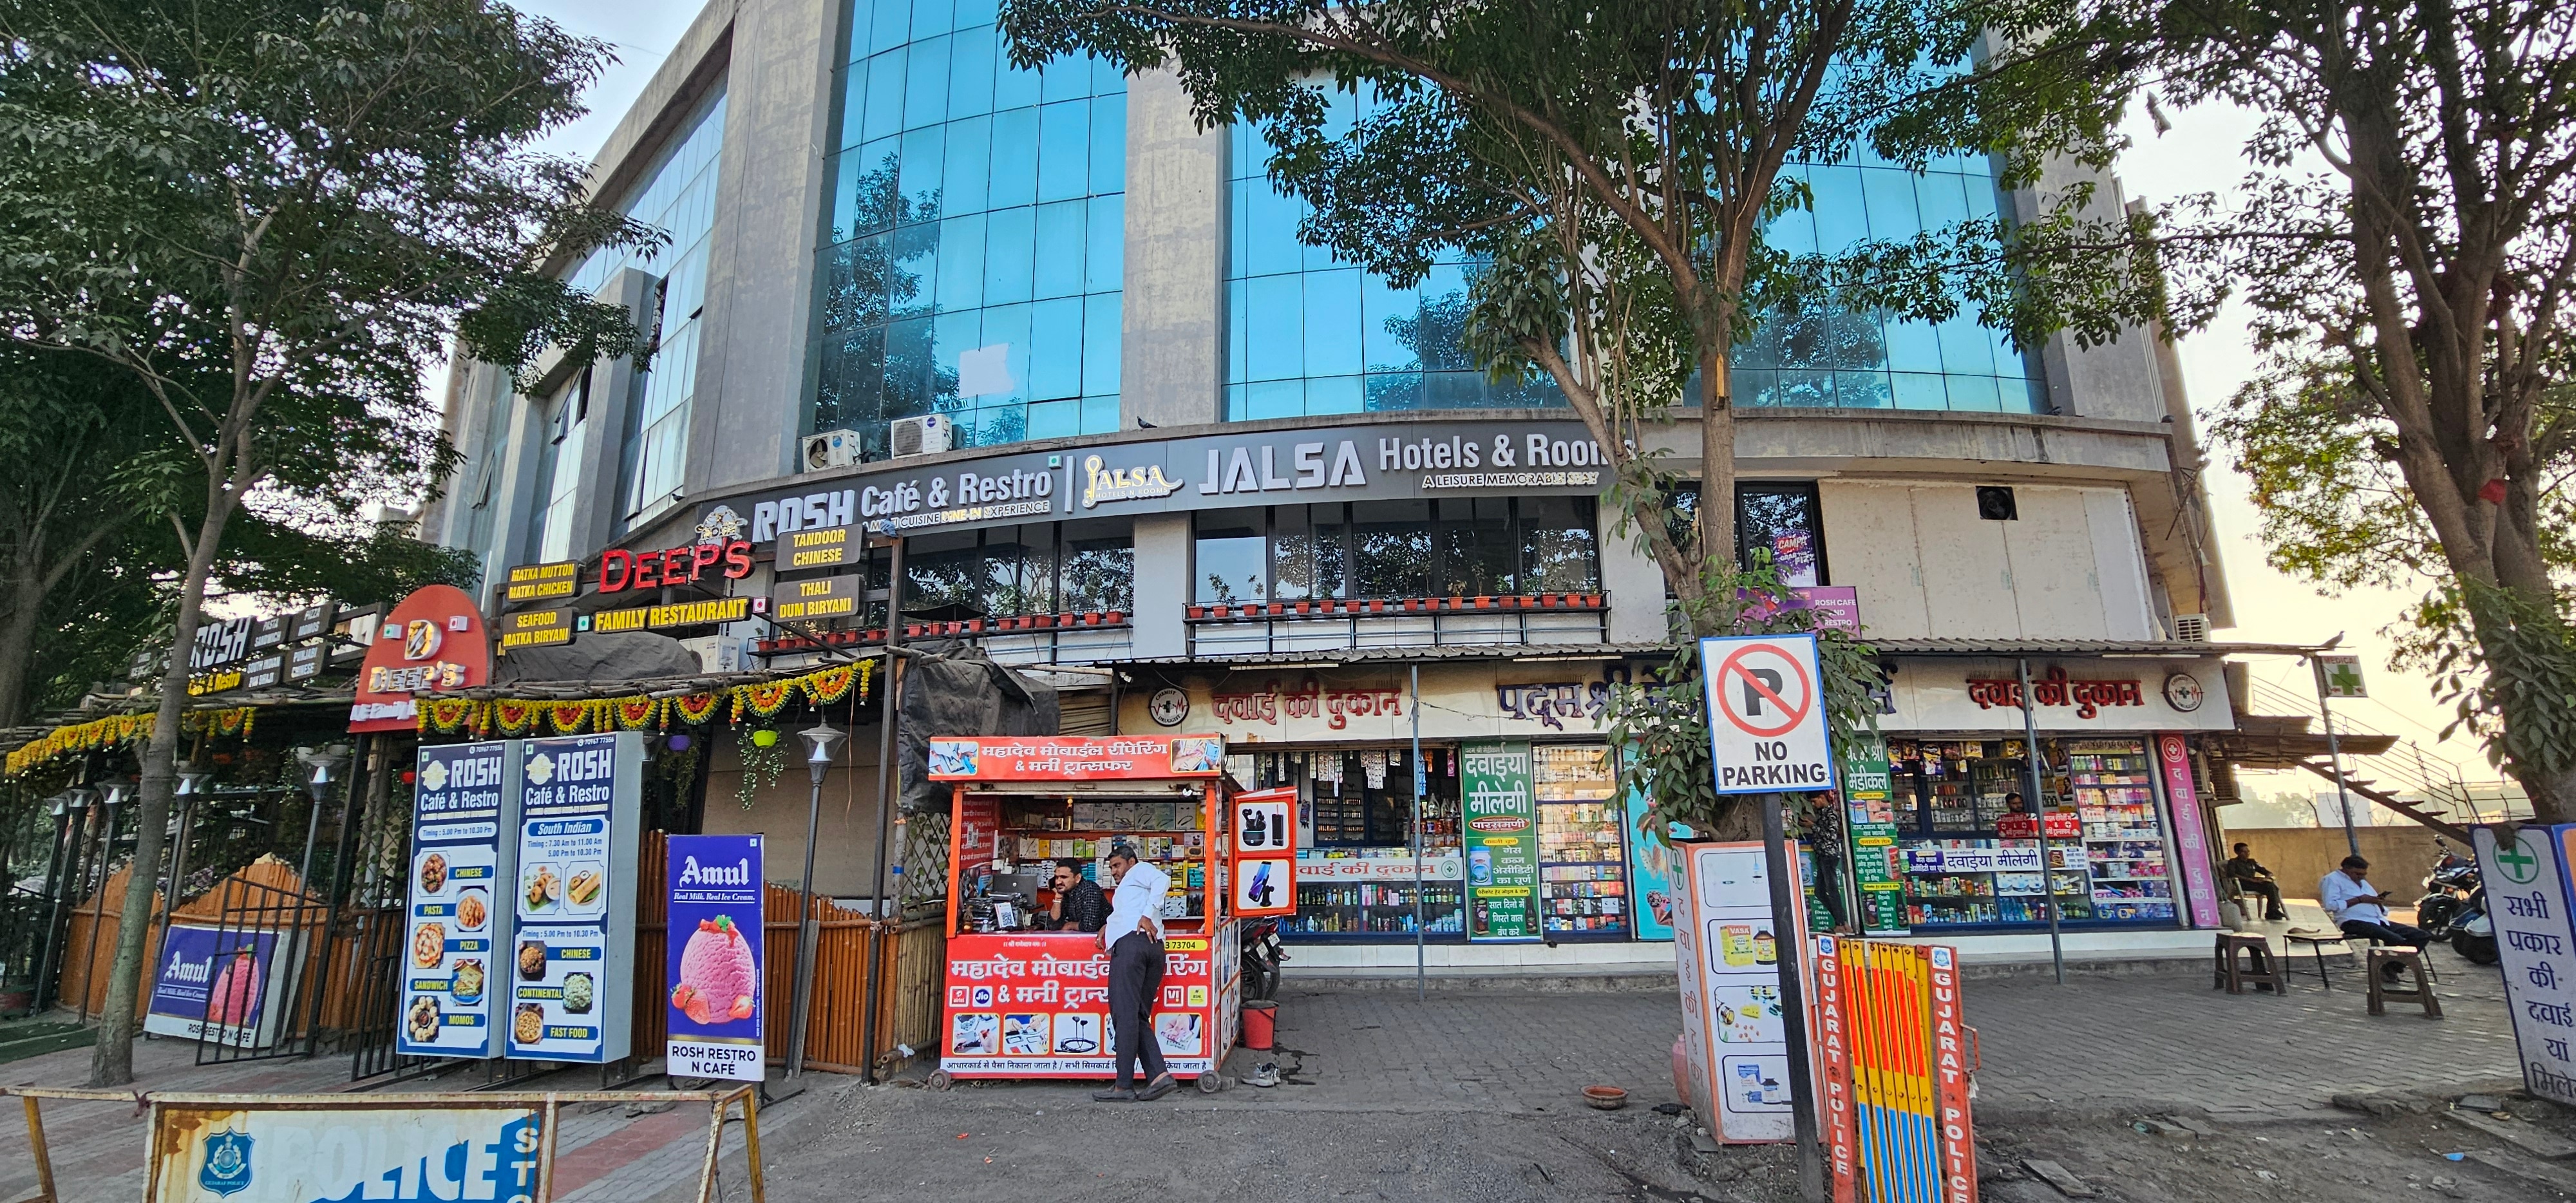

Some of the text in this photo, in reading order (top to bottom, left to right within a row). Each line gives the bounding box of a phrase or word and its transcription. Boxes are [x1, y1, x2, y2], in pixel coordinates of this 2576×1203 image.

[1198, 434, 1516, 495] JALSA Hotels &
[1423, 475, 1435, 488] A
[1435, 473, 1482, 487] LEISURE
[1486, 472, 1566, 486] MEMORABLE
[752, 469, 1053, 543] ROSH Café & Restro
[901, 511, 940, 528] CUISINE
[793, 529, 846, 547] TANDOOR
[1778, 535, 1807, 549] CAMPA
[598, 536, 756, 593] DEEP'S
[793, 548, 842, 566] CHINESE
[511, 564, 574, 582] MATKA MUTTON
[509, 581, 573, 599] MATKA CHICKEN
[800, 581, 831, 596] THALI
[595, 598, 748, 630] FAMILY RESTAURANT
[780, 598, 851, 618] DUM BIRYANI
[517, 612, 556, 627] SEAFOOD
[189, 615, 252, 668] ROSH
[504, 628, 569, 647] MATKA BIRYANI
[215, 672, 241, 690] Restro
[368, 661, 465, 692] DEEP'S
[1155, 690, 1177, 701] CHEMIST
[1212, 675, 1403, 730] दवाई की दुकान
[2032, 667, 2070, 706] की
[2071, 679, 2145, 719] दुकान
[1158, 714, 1180, 723] DRUGGIST
[981, 743, 1036, 757] महादेव
[1040, 743, 1103, 757] मोबाईल
[1754, 741, 1788, 761] NO
[451, 756, 502, 788] ROSH
[557, 749, 612, 782] ROSH
[1016, 758, 1133, 775] & मनी ट्रान्सफर
[1465, 742, 1526, 782] दवाईया
[1722, 763, 1826, 786] PARKING
[1849, 764, 1887, 791] मेडीकल
[421, 790, 498, 811] Café & Restro
[526, 784, 609, 805] Café & Restro
[1469, 780, 1527, 813] मीलेगी
[422, 829, 438, 837] Timing
[538, 822, 592, 835] South Indian
[1296, 862, 1435, 877] वाई की दुकान
[1946, 850, 1992, 871] दवाईया
[1996, 849, 2038, 867] मीलेगी
[455, 867, 482, 878] CHINESE
[679, 855, 750, 888] Amul
[424, 905, 443, 915] PASTA
[2504, 891, 2550, 919] सभी
[460, 941, 478, 951] PIZZA
[2506, 930, 2561, 955] प्रकार
[561, 949, 591, 959] CHINESE
[164, 951, 213, 983] Amul
[951, 953, 1027, 979] महादेव
[2527, 961, 2557, 990] की
[414, 980, 448, 990] SANDWICH
[518, 988, 563, 998] CONTINENTAL
[998, 980, 1059, 1003] & मनी
[449, 1016, 474, 1025] MOMOS
[2526, 1000, 2575, 1027] दवाई
[227, 1031, 233, 1039] N
[551, 1027, 587, 1038] FAST FOOD
[672, 1045, 756, 1062] ROSH RESTRO
[2544, 1037, 2570, 1061] यां
[692, 1060, 735, 1075] N CAFÉ
[947, 1060, 981, 1068] आधारकार्ड
[983, 1060, 989, 1068] से
[992, 1060, 1005, 1068] पैसा
[1008, 1060, 1032, 1069] निकाला
[1053, 1060, 1057, 1070] है
[1066, 1061, 1079, 1069] सभी
[1082, 1060, 1110, 1069] सिमकार्ड
[1202, 1061, 1206, 1070] है
[1821, 959, 1848, 1175] GUJARAT POLICE
[1935, 972, 1968, 1203] GUJARAT POLICE
[269, 1126, 504, 1200] POLICE
